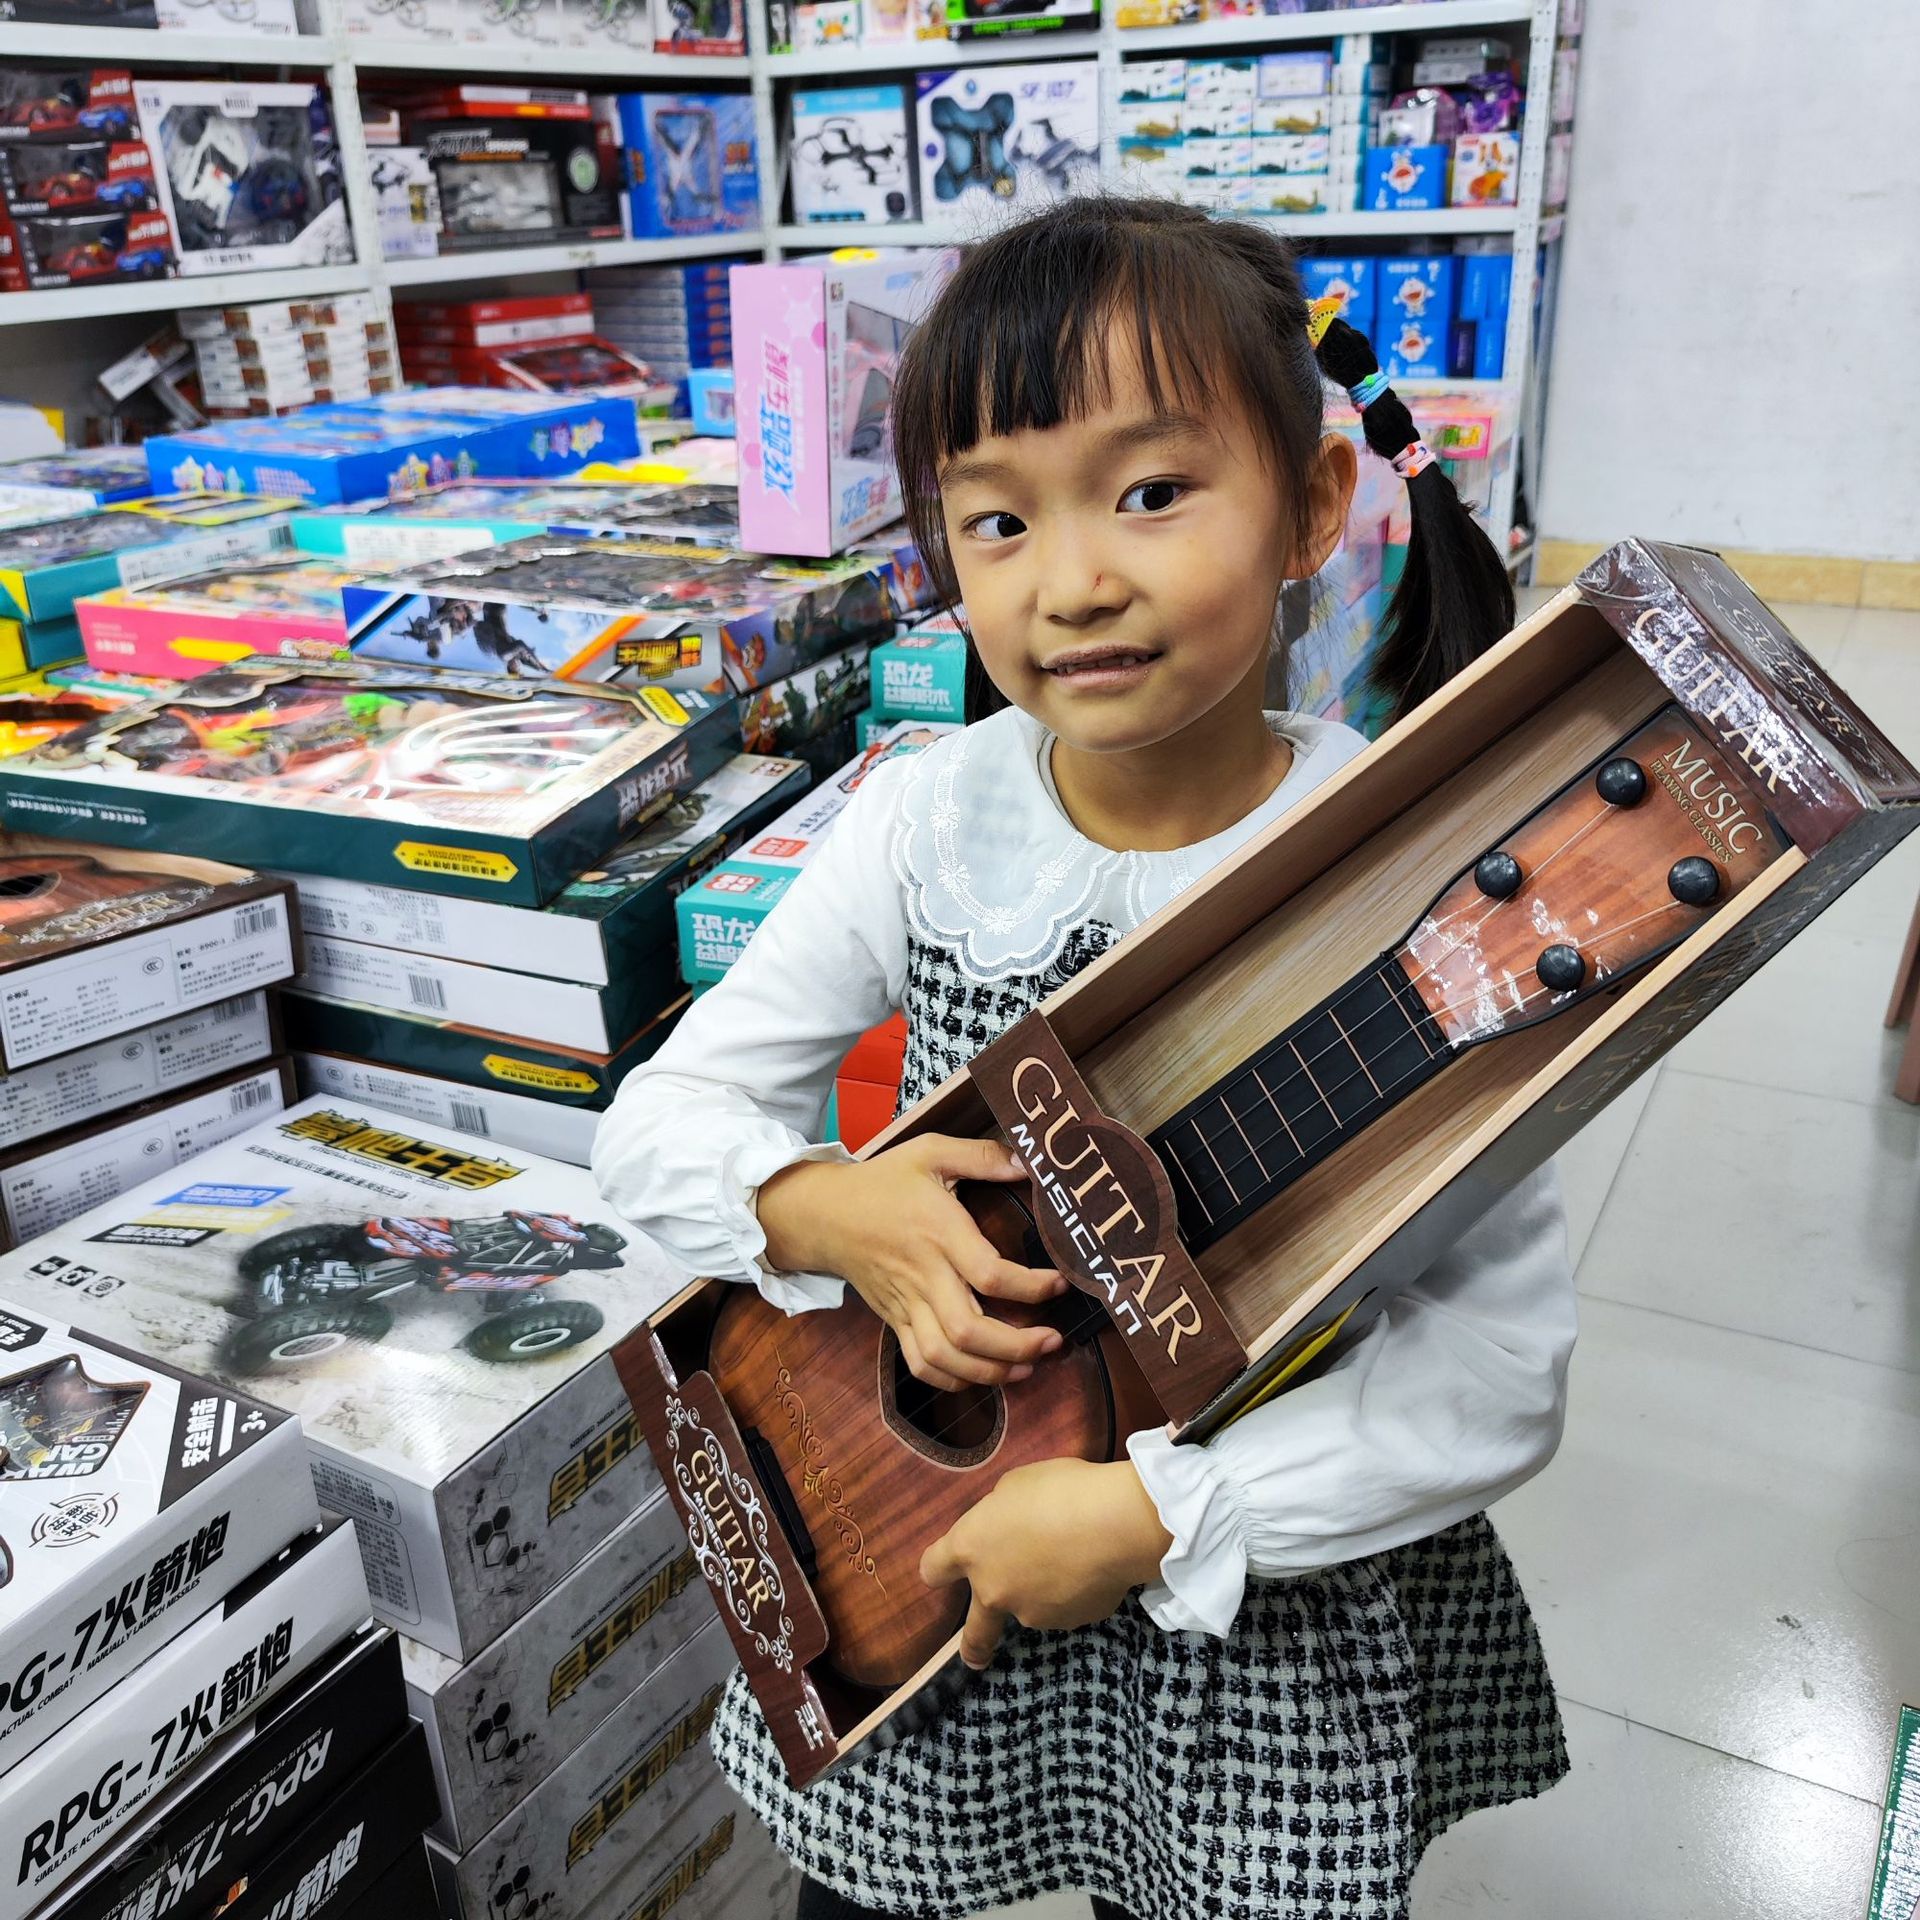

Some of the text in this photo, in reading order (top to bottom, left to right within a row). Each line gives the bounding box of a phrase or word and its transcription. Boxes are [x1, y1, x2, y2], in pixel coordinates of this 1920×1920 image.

[883, 661, 933, 687] 恐龙
[1634, 607, 1798, 794] GUITAR
[1650, 760, 1733, 864] PLAYING CLASSICS
[1664, 738, 1763, 855] MUSIC
[1010, 1122, 1143, 1337] MUSICIAN
[1012, 1056, 1204, 1366] GUITAR
[182, 1397, 218, 1468] 安全射击
[240, 1410, 267, 1434] 3+
[690, 1450, 771, 1615] GUITAR
[692, 1490, 739, 1587] MUSICIAN
[0, 1576, 201, 1740] ACTUAL COMBAT MANUALLY LAUNCH MISSILES
[33, 1845, 79, 1887] SIMULATE
[79, 1816, 114, 1848] ACTUAL
[115, 1784, 154, 1819] COMBAT
